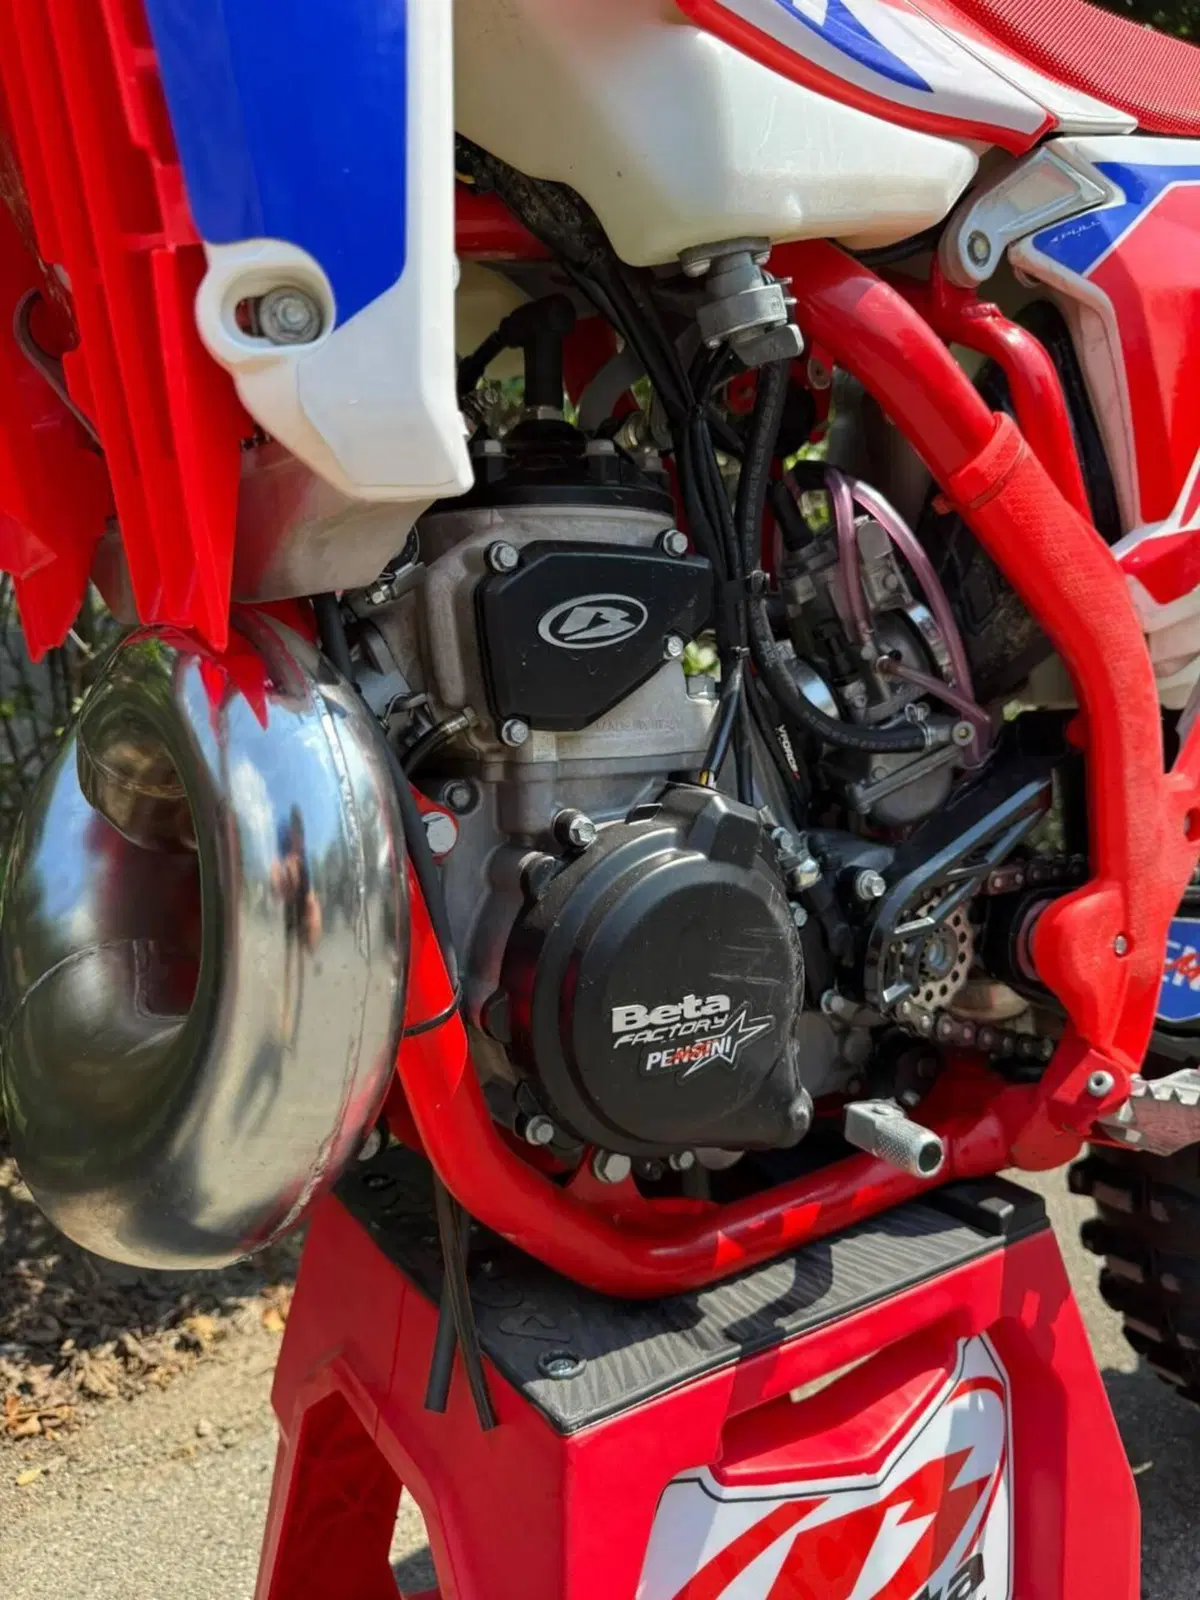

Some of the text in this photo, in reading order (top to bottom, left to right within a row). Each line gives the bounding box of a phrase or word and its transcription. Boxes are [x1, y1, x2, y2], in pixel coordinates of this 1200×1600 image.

[611, 993, 731, 1034] Beta
[613, 1013, 729, 1050] FACTORY
[646, 1034, 732, 1071] PENSINI
